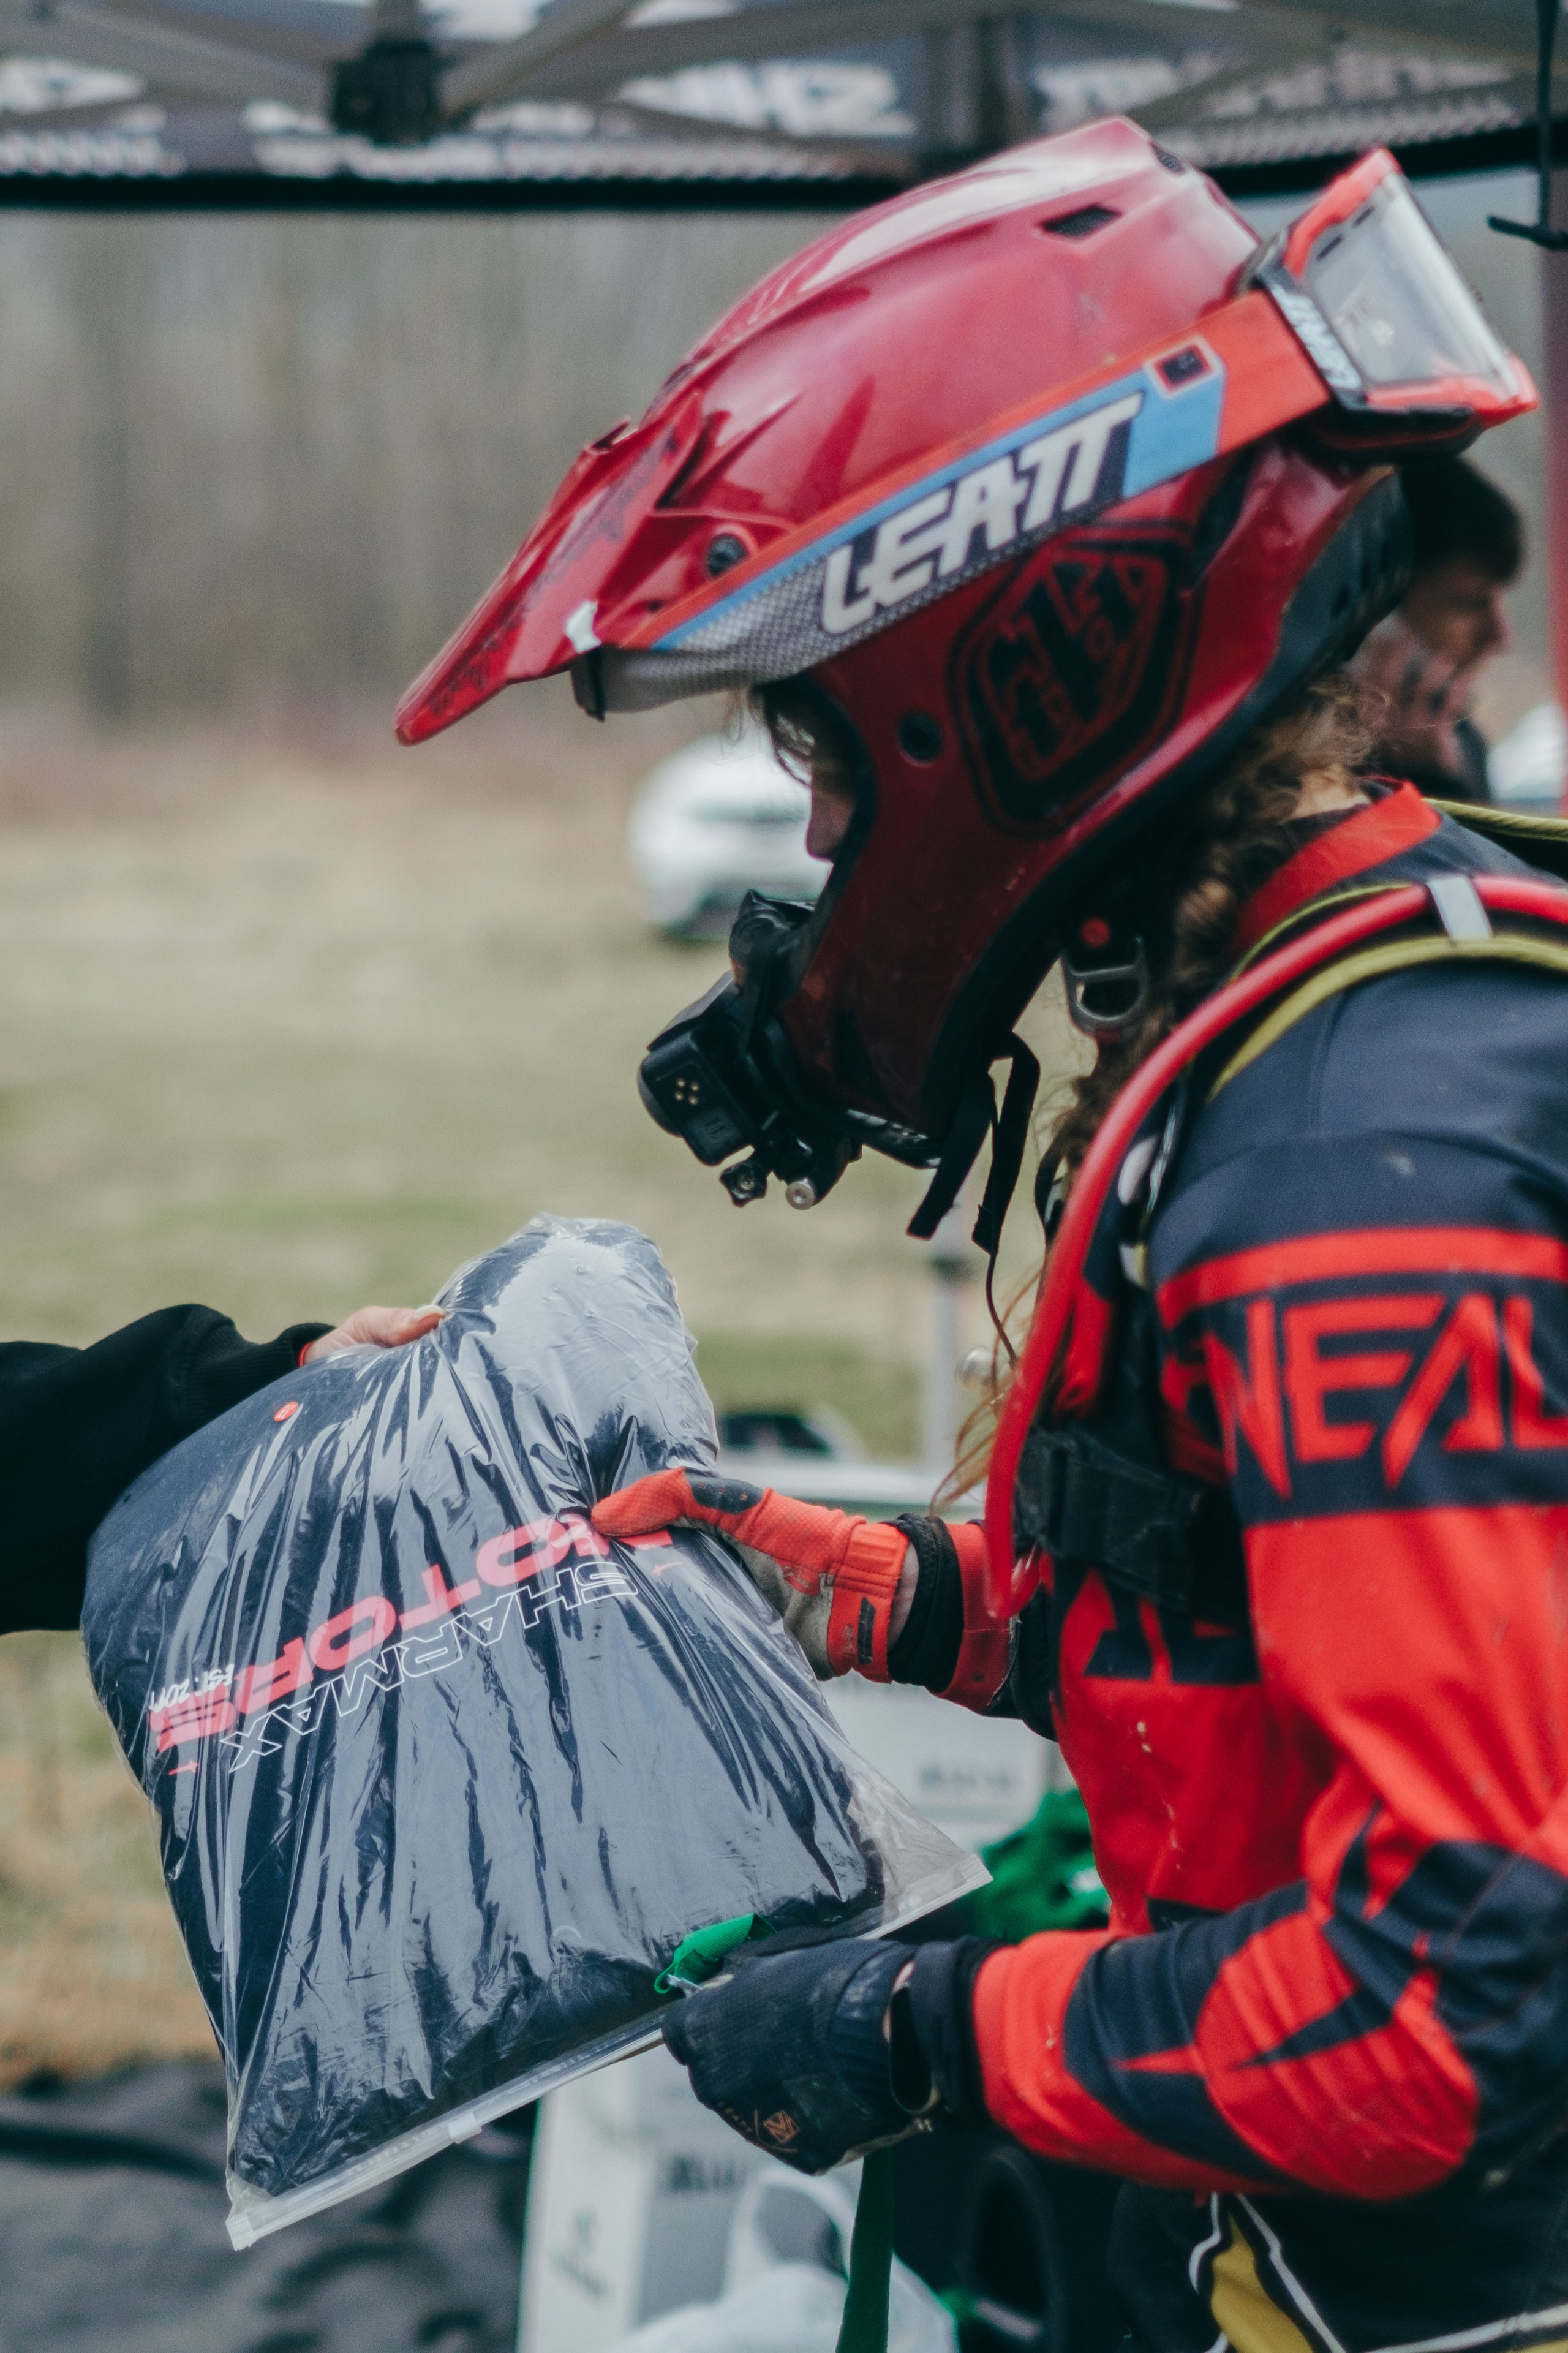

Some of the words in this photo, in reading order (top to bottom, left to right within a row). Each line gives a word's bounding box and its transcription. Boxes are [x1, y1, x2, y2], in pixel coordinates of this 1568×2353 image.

[821, 389, 1145, 635] LEATT
[194, 1664, 235, 1697] EST.
[220, 1560, 639, 1773] SHARMAX
